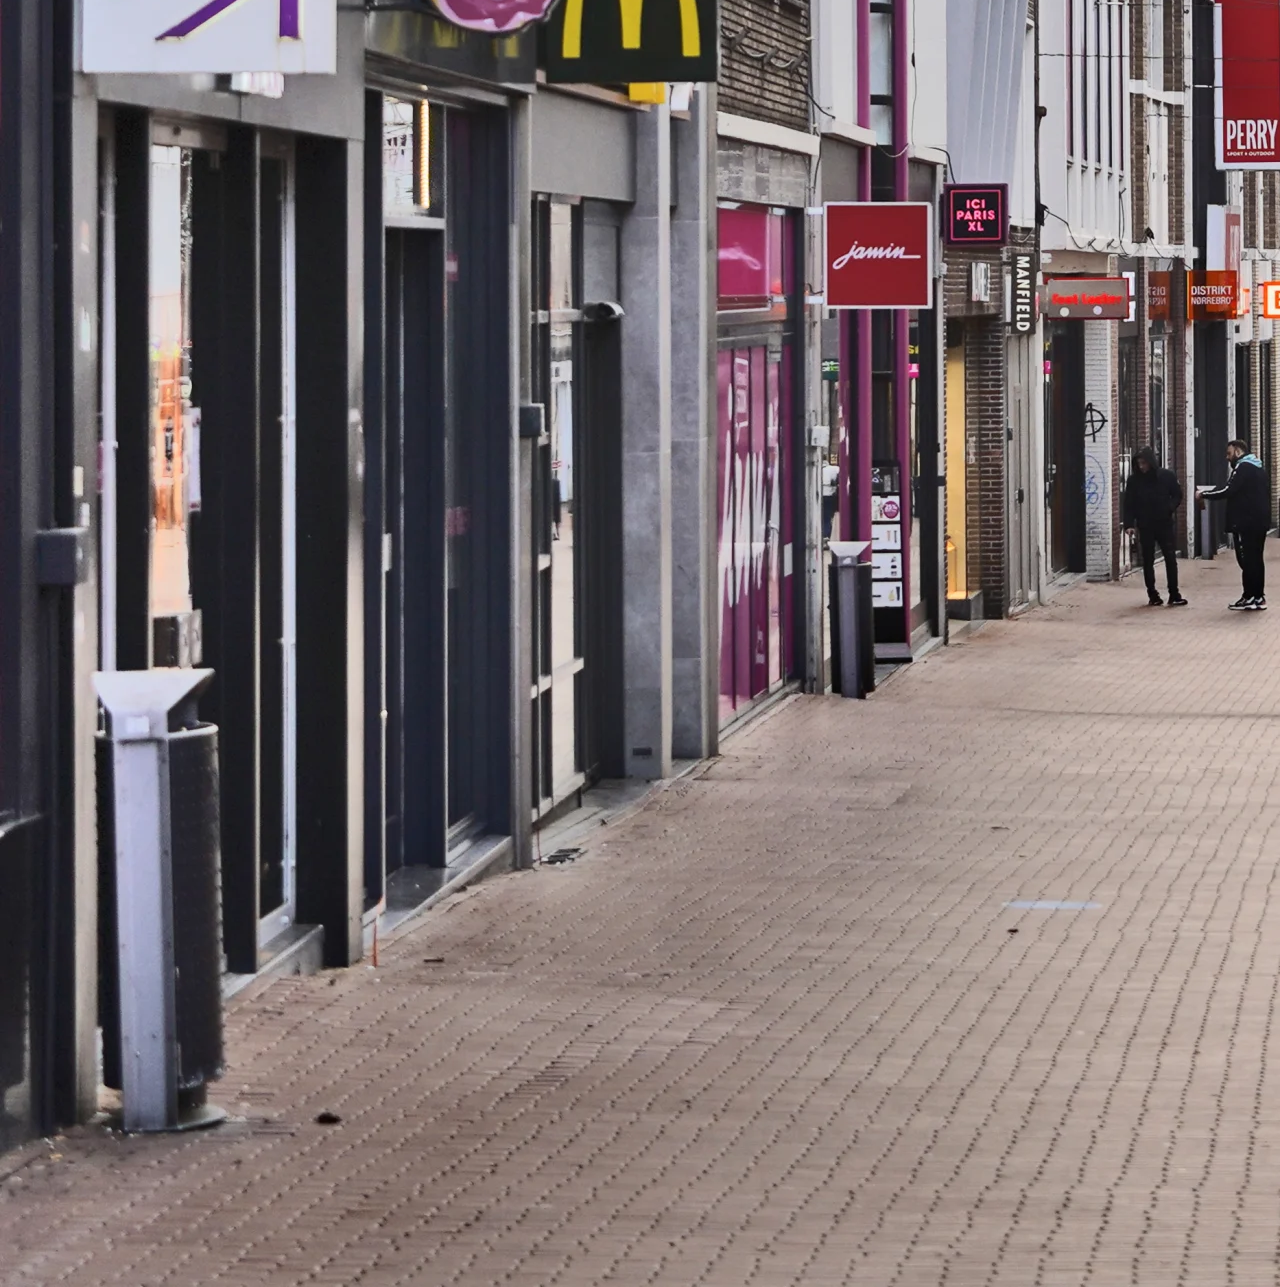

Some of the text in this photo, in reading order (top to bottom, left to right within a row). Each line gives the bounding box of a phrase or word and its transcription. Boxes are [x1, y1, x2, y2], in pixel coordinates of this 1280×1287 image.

[1227, 119, 1278, 150] PERRY
[966, 199, 986, 209] ICI
[956, 210, 995, 220] PARIS
[968, 221, 984, 231] XL
[833, 241, 921, 270] jamin
[1016, 256, 1031, 332] MANFIELD
[1191, 286, 1232, 295] DISTRIKT
